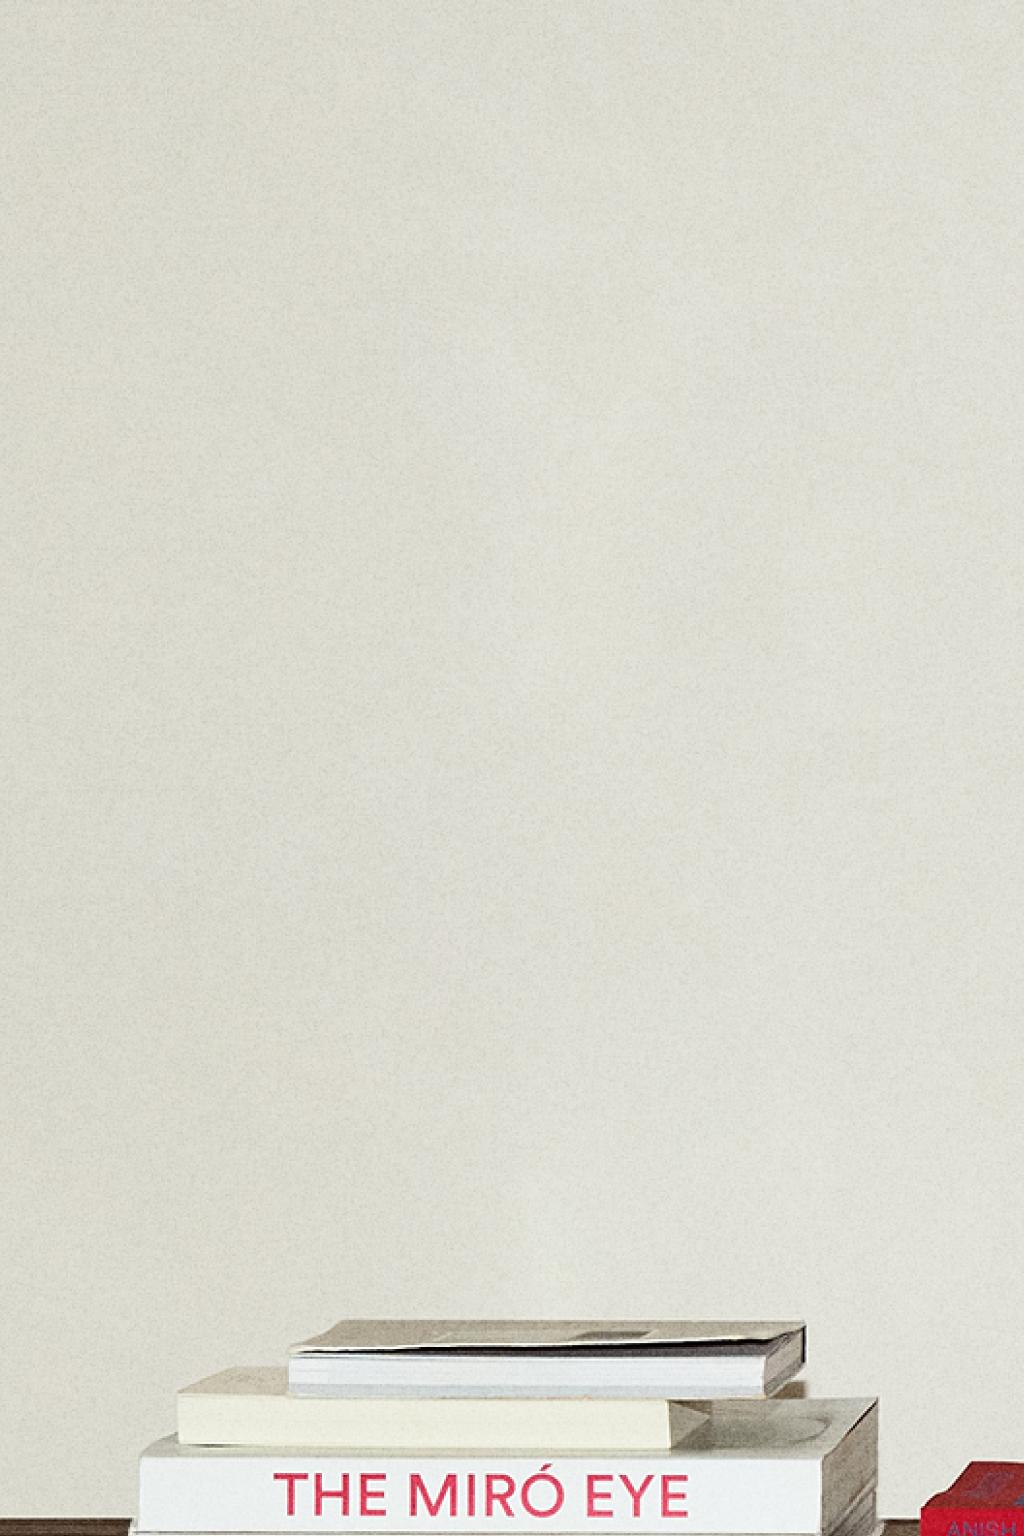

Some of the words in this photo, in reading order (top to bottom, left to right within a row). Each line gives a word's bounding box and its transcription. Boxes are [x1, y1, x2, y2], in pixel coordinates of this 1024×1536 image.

[272, 1472, 387, 1517] THE
[409, 1463, 565, 1519] MIRÓ
[586, 1473, 689, 1519] EYE
